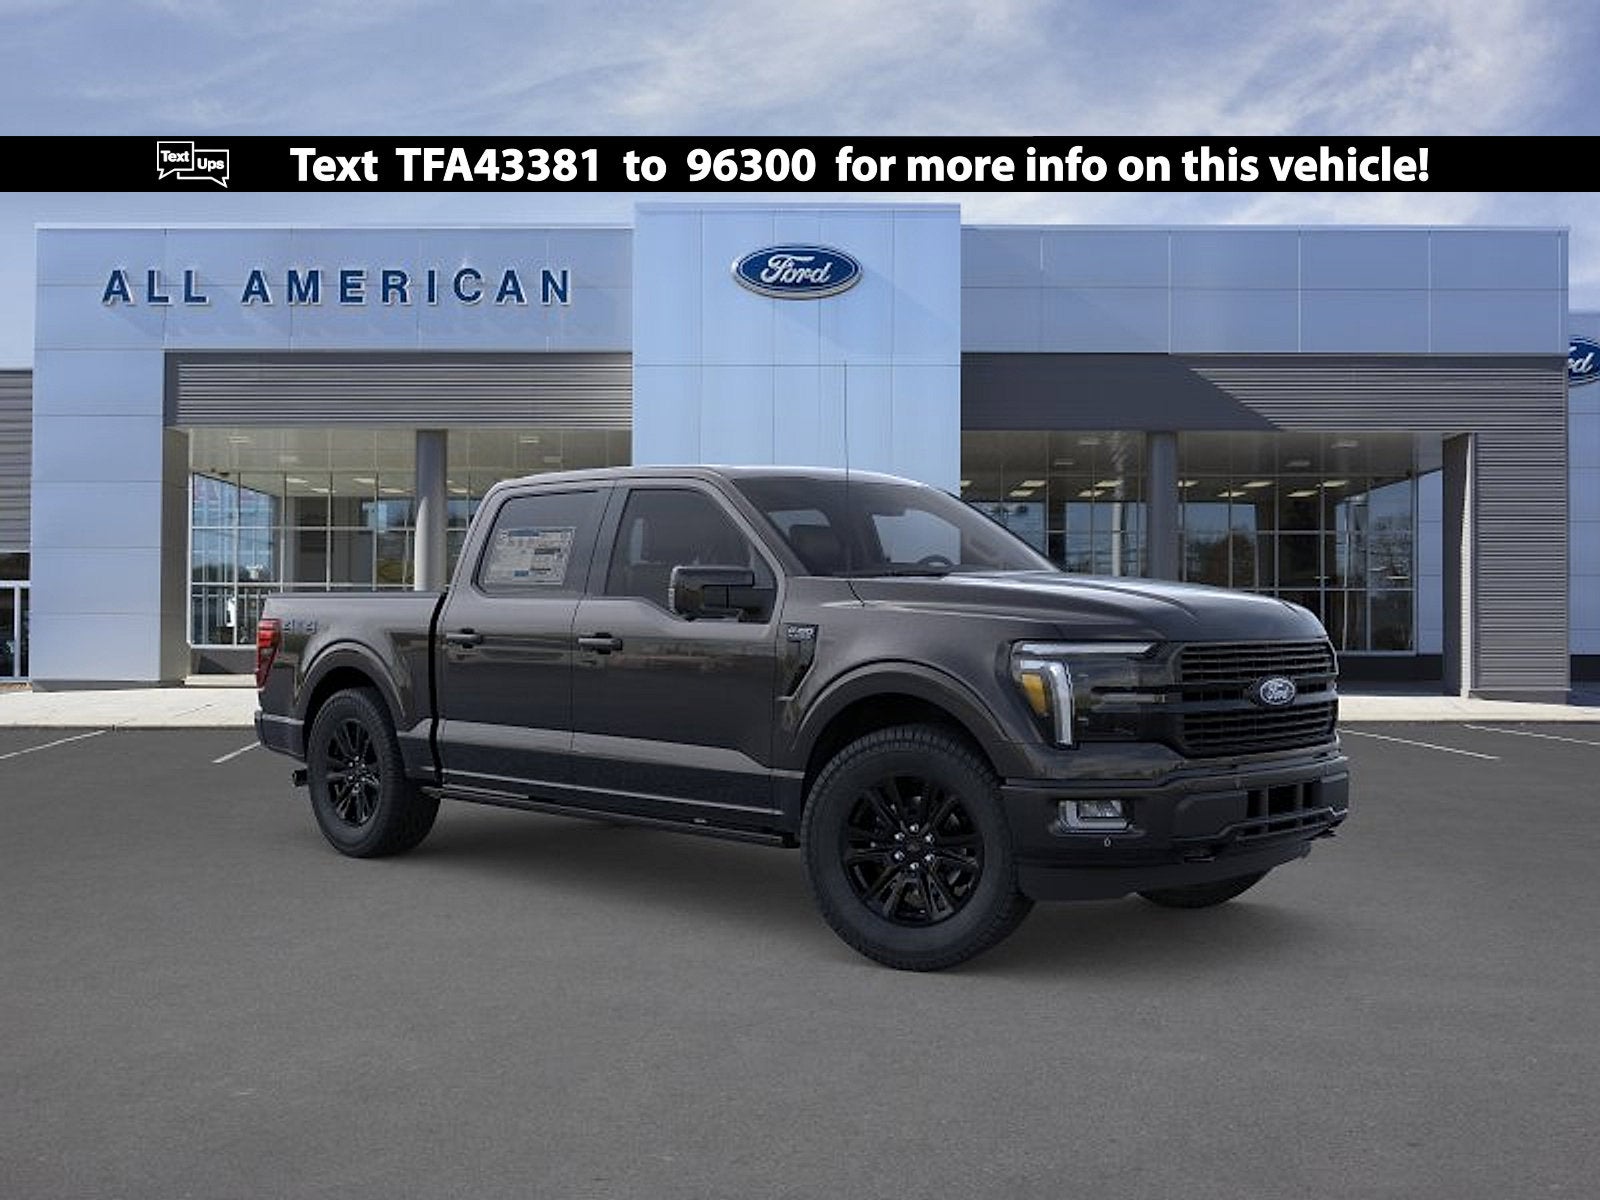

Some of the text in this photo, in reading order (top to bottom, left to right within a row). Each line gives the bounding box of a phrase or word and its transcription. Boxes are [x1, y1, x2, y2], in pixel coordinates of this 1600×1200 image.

[760, 253, 833, 284] Ford
[102, 268, 571, 304] ALL AMERICAN
